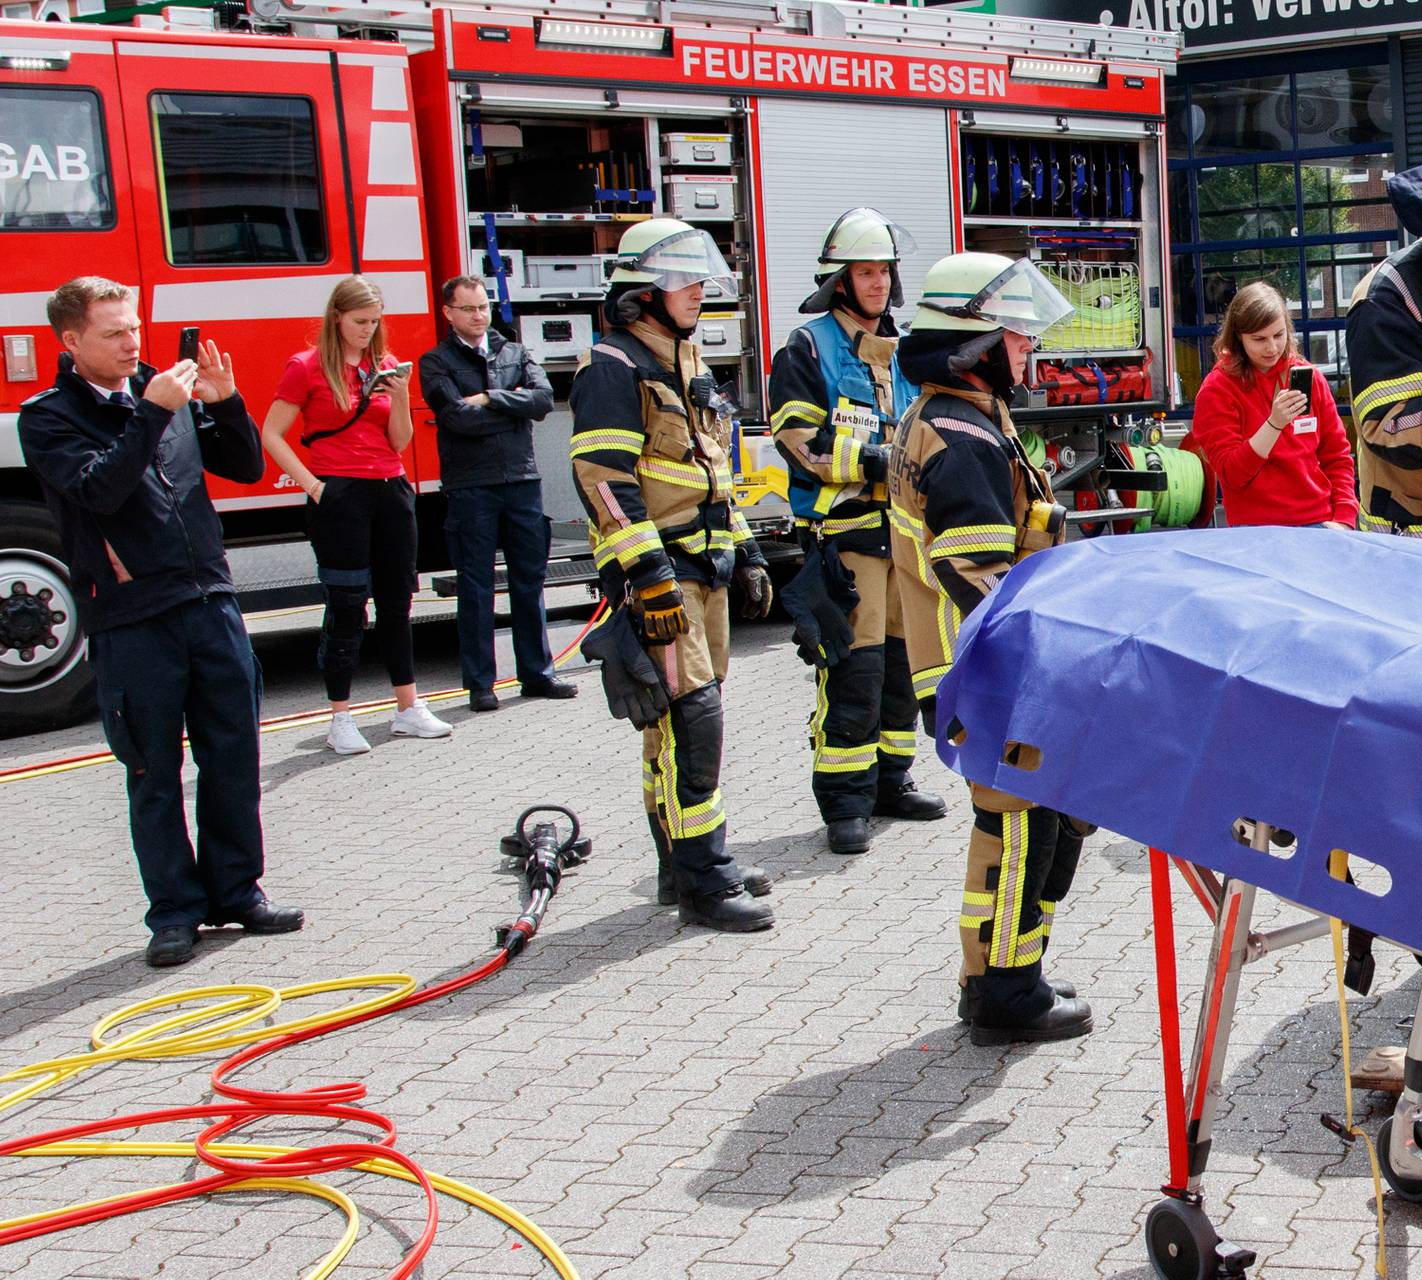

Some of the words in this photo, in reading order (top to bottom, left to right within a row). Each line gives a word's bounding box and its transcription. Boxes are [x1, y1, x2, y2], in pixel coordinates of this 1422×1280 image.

[682, 45, 896, 90] FEUERWEHR
[908, 62, 1006, 97] ESSEN
[834, 412, 878, 429] Ausbilder
